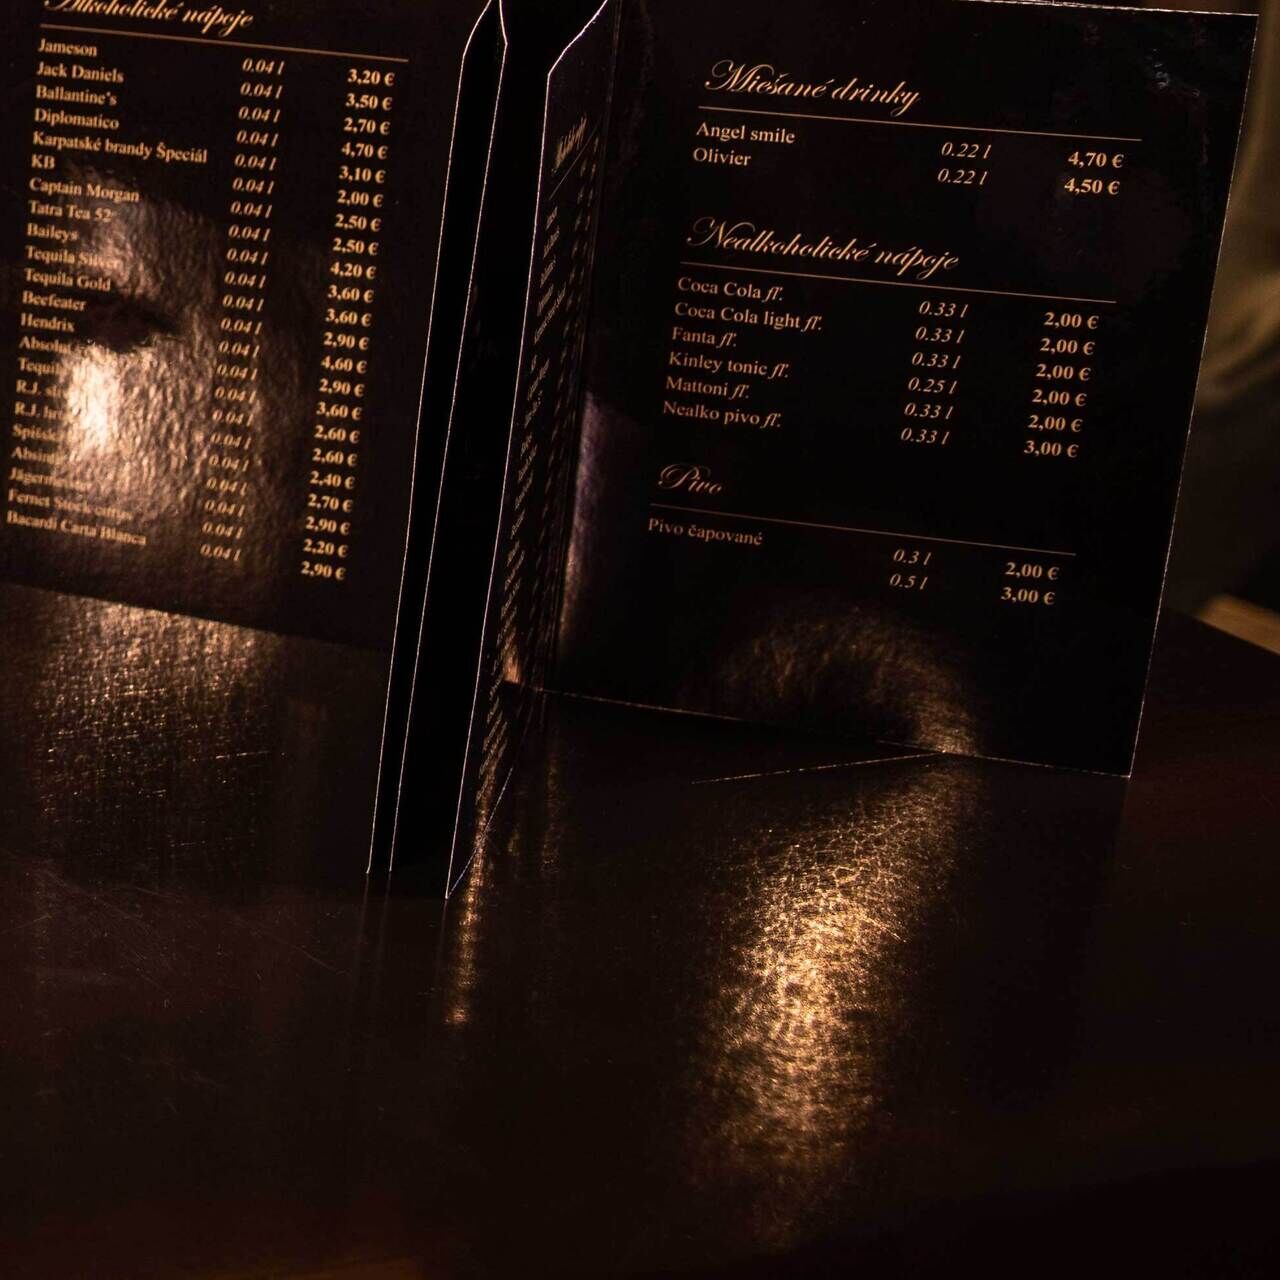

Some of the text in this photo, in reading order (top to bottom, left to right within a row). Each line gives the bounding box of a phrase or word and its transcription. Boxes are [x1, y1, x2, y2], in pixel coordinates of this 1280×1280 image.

[181, 1, 254, 37] nápoje
[37, 61, 67, 77] Jack
[71, 64, 124, 82] Daniels
[345, 92, 378, 109] 3,50
[38, 38, 97, 56] Jameson
[347, 68, 381, 84] 3,20
[35, 84, 117, 105] Ballantine's
[344, 117, 376, 133] 2,70
[704, 59, 920, 117] Miešané drinky
[32, 130, 102, 151] Karpatské
[104, 138, 152, 160] brandy
[156, 142, 207, 163] Špeciál
[339, 165, 372, 181] 3,10
[34, 107, 119, 129] Diplomatico
[341, 142, 374, 157] 4,70
[696, 122, 745, 142] Angel
[750, 127, 795, 144] smile
[1068, 151, 1107, 167] 4,70
[31, 154, 55, 169] KB
[337, 189, 369, 205] 2,00
[693, 147, 751, 166] Olivier
[1064, 178, 1103, 194] 4,50
[29, 178, 82, 196] Captain
[85, 184, 140, 208] Morgan
[335, 213, 367, 229] 2,50
[30, 200, 63, 217] Tatra
[67, 204, 91, 220] Tea
[332, 237, 365, 253] 2,50
[24, 246, 76, 269] Tequila
[327, 284, 360, 301] 3,60
[26, 224, 78, 247] Baileys
[330, 261, 362, 277] 4,20
[686, 219, 959, 280] Nealkoholické nápoje
[22, 290, 86, 311] Beefeater
[323, 331, 355, 348] 2,90
[23, 269, 74, 292] Tequila
[76, 276, 111, 294] Gold
[325, 308, 358, 324] 3,60
[677, 277, 718, 294] Coca
[723, 282, 761, 298] Cola
[1044, 311, 1082, 328] 2,00
[20, 312, 74, 332] Hendrix
[321, 355, 353, 371] 4,60
[672, 326, 715, 344] Fanta
[1035, 363, 1074, 379] 2,00
[674, 302, 715, 319] Coca
[720, 307, 758, 324] Cola
[763, 311, 800, 330] light
[1039, 337, 1078, 353] 2,00
[319, 378, 351, 394] 2,90
[666, 375, 728, 396] Mattoni
[1028, 414, 1066, 430] 2,00
[669, 351, 722, 373] Kinley
[727, 360, 767, 375] tonic
[1032, 388, 1070, 405] 2,00
[314, 424, 346, 441] 2,60
[316, 401, 348, 418] 3,60
[663, 400, 720, 419] Nealko
[723, 408, 760, 425] pivo
[1023, 440, 1062, 456] 3,00
[310, 470, 341, 487] 2,40
[312, 447, 344, 464] 2,60
[657, 463, 722, 494] Pivo
[305, 515, 337, 532] 2,90
[307, 493, 339, 510] 2,70
[6, 509, 58, 530] Bacardi
[301, 560, 332, 577] 2,90
[303, 538, 334, 555] 2,20
[648, 517, 683, 534] Pivo
[687, 524, 762, 545] čapované
[1005, 561, 1042, 578] 2,00
[1000, 586, 1038, 603] 3,00
